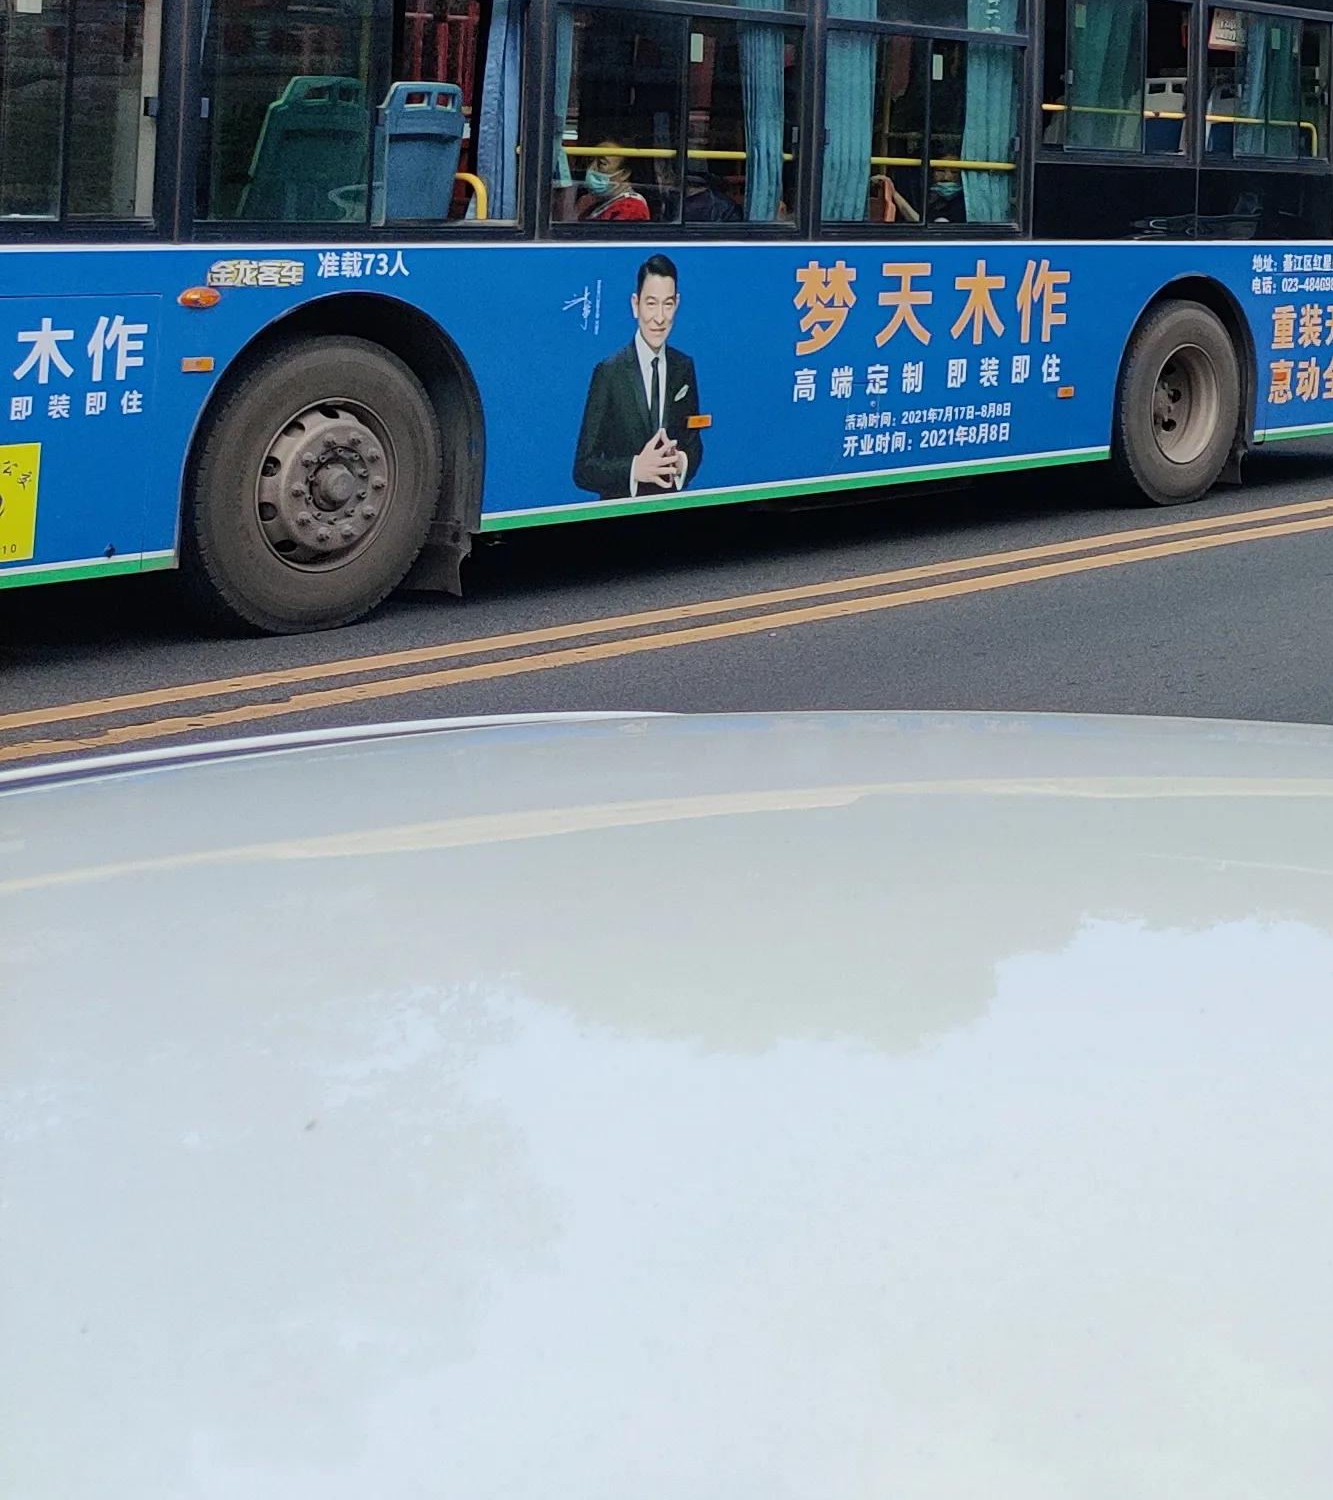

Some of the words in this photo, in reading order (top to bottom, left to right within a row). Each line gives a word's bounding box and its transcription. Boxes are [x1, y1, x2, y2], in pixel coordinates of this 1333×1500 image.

[207, 259, 305, 287] 金龙客车
[316, 251, 410, 278] 准载73人
[792, 259, 1071, 357] 梦天木作
[13, 314, 150, 384] 木作
[793, 360, 924, 403] 高端定制
[946, 353, 1061, 389] 即装即住
[9, 389, 144, 421] 即装即住
